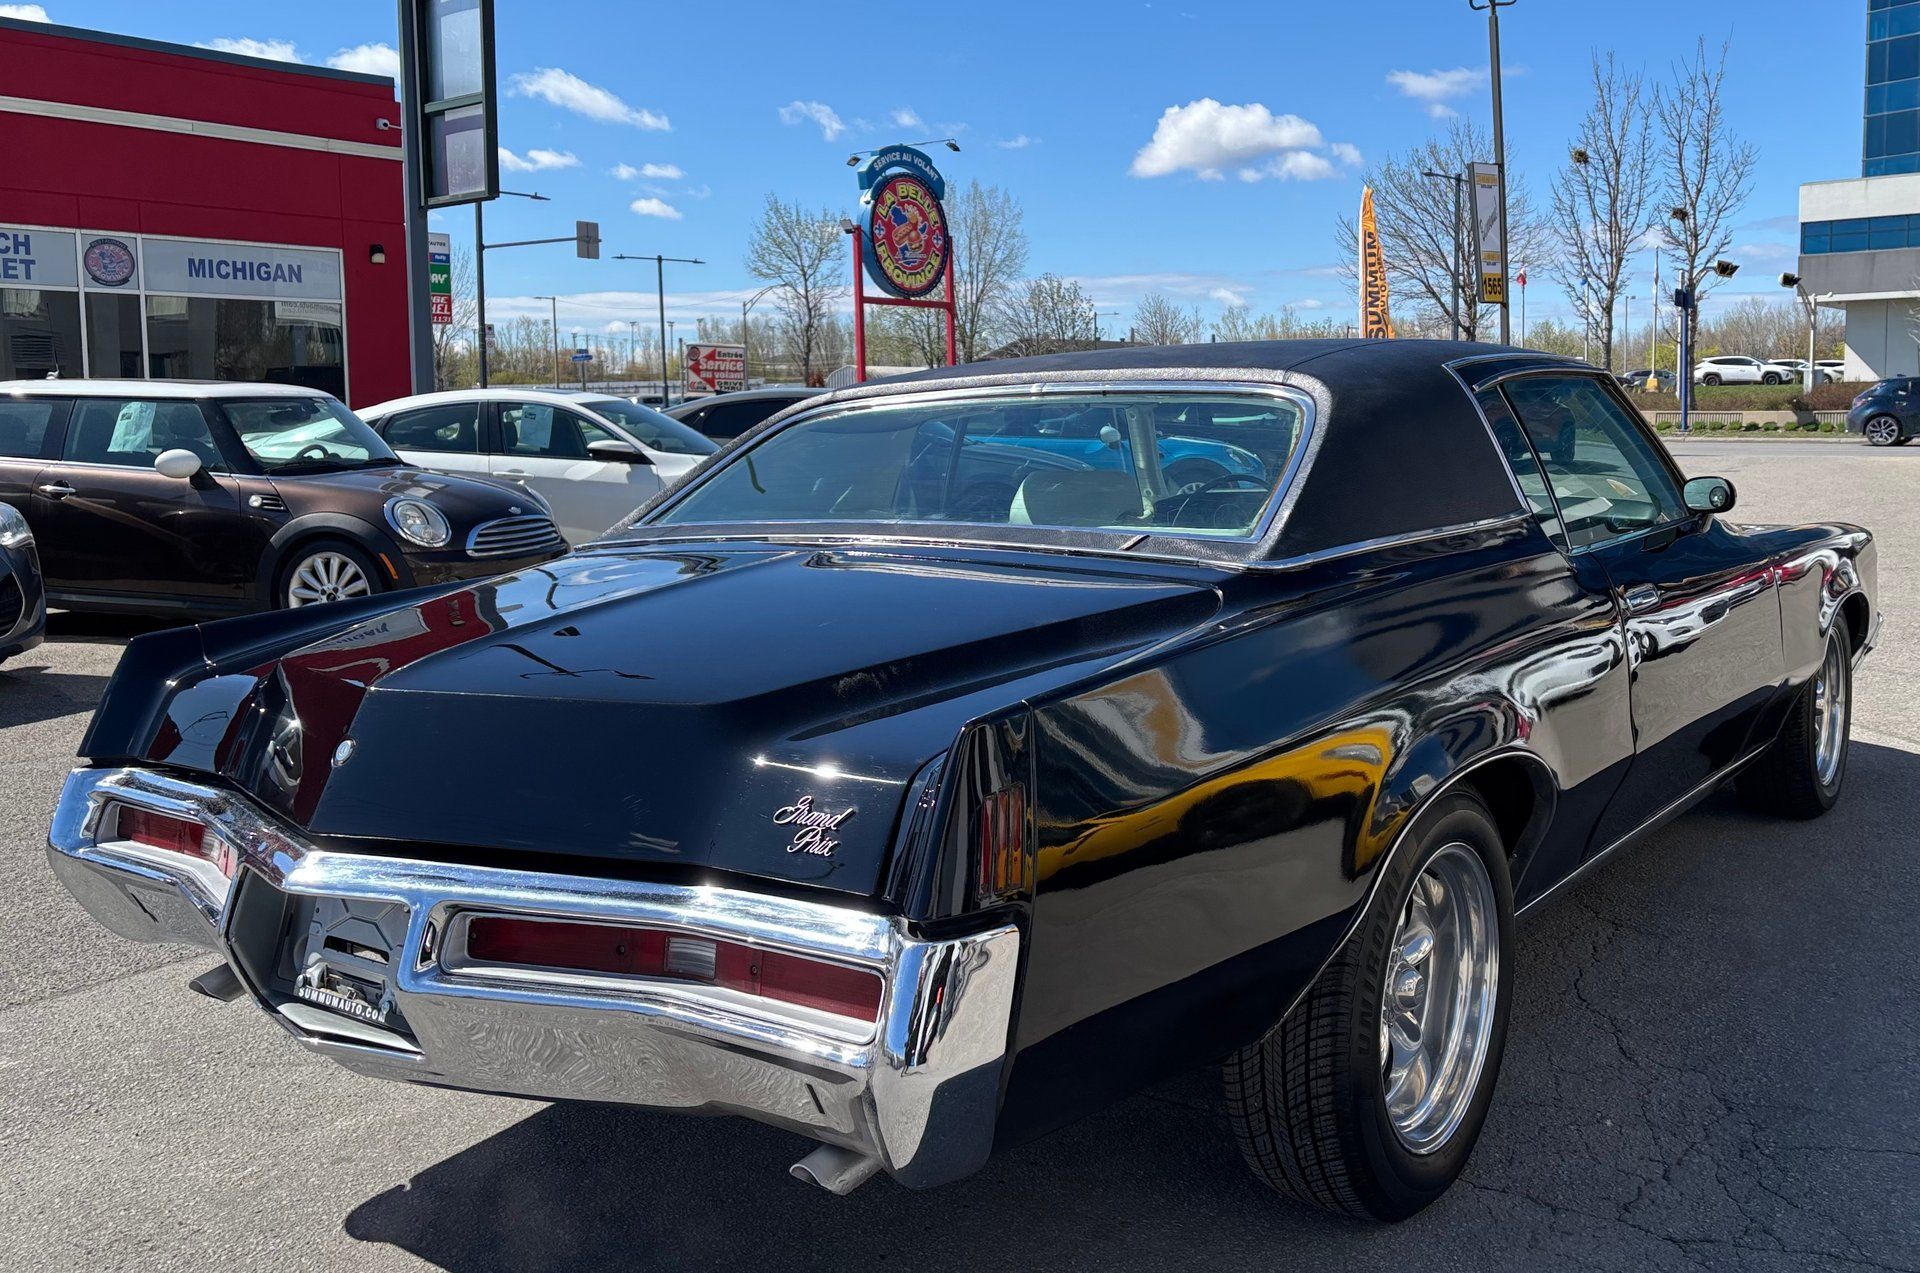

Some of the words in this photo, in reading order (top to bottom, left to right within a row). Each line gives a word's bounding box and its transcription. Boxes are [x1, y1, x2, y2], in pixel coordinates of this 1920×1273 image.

[873, 151, 901, 170] SERVICE
[902, 153, 912, 162] AU
[913, 154, 939, 182] VOLANT
[876, 190, 897, 219] LA
[896, 182, 940, 229] BELLE
[0, 257, 36, 280] ET
[187, 257, 302, 283] MICHIGAN
[876, 241, 942, 287] PROVINCE
[431, 273, 448, 284] AY
[1367, 231, 1386, 338] SUMMUM
[1484, 277, 1502, 296] 1565
[699, 358, 744, 371] Service
[717, 350, 743, 358] Entrée
[714, 370, 744, 379] volant
[773, 795, 854, 830] Grand
[786, 826, 838, 857] Prix
